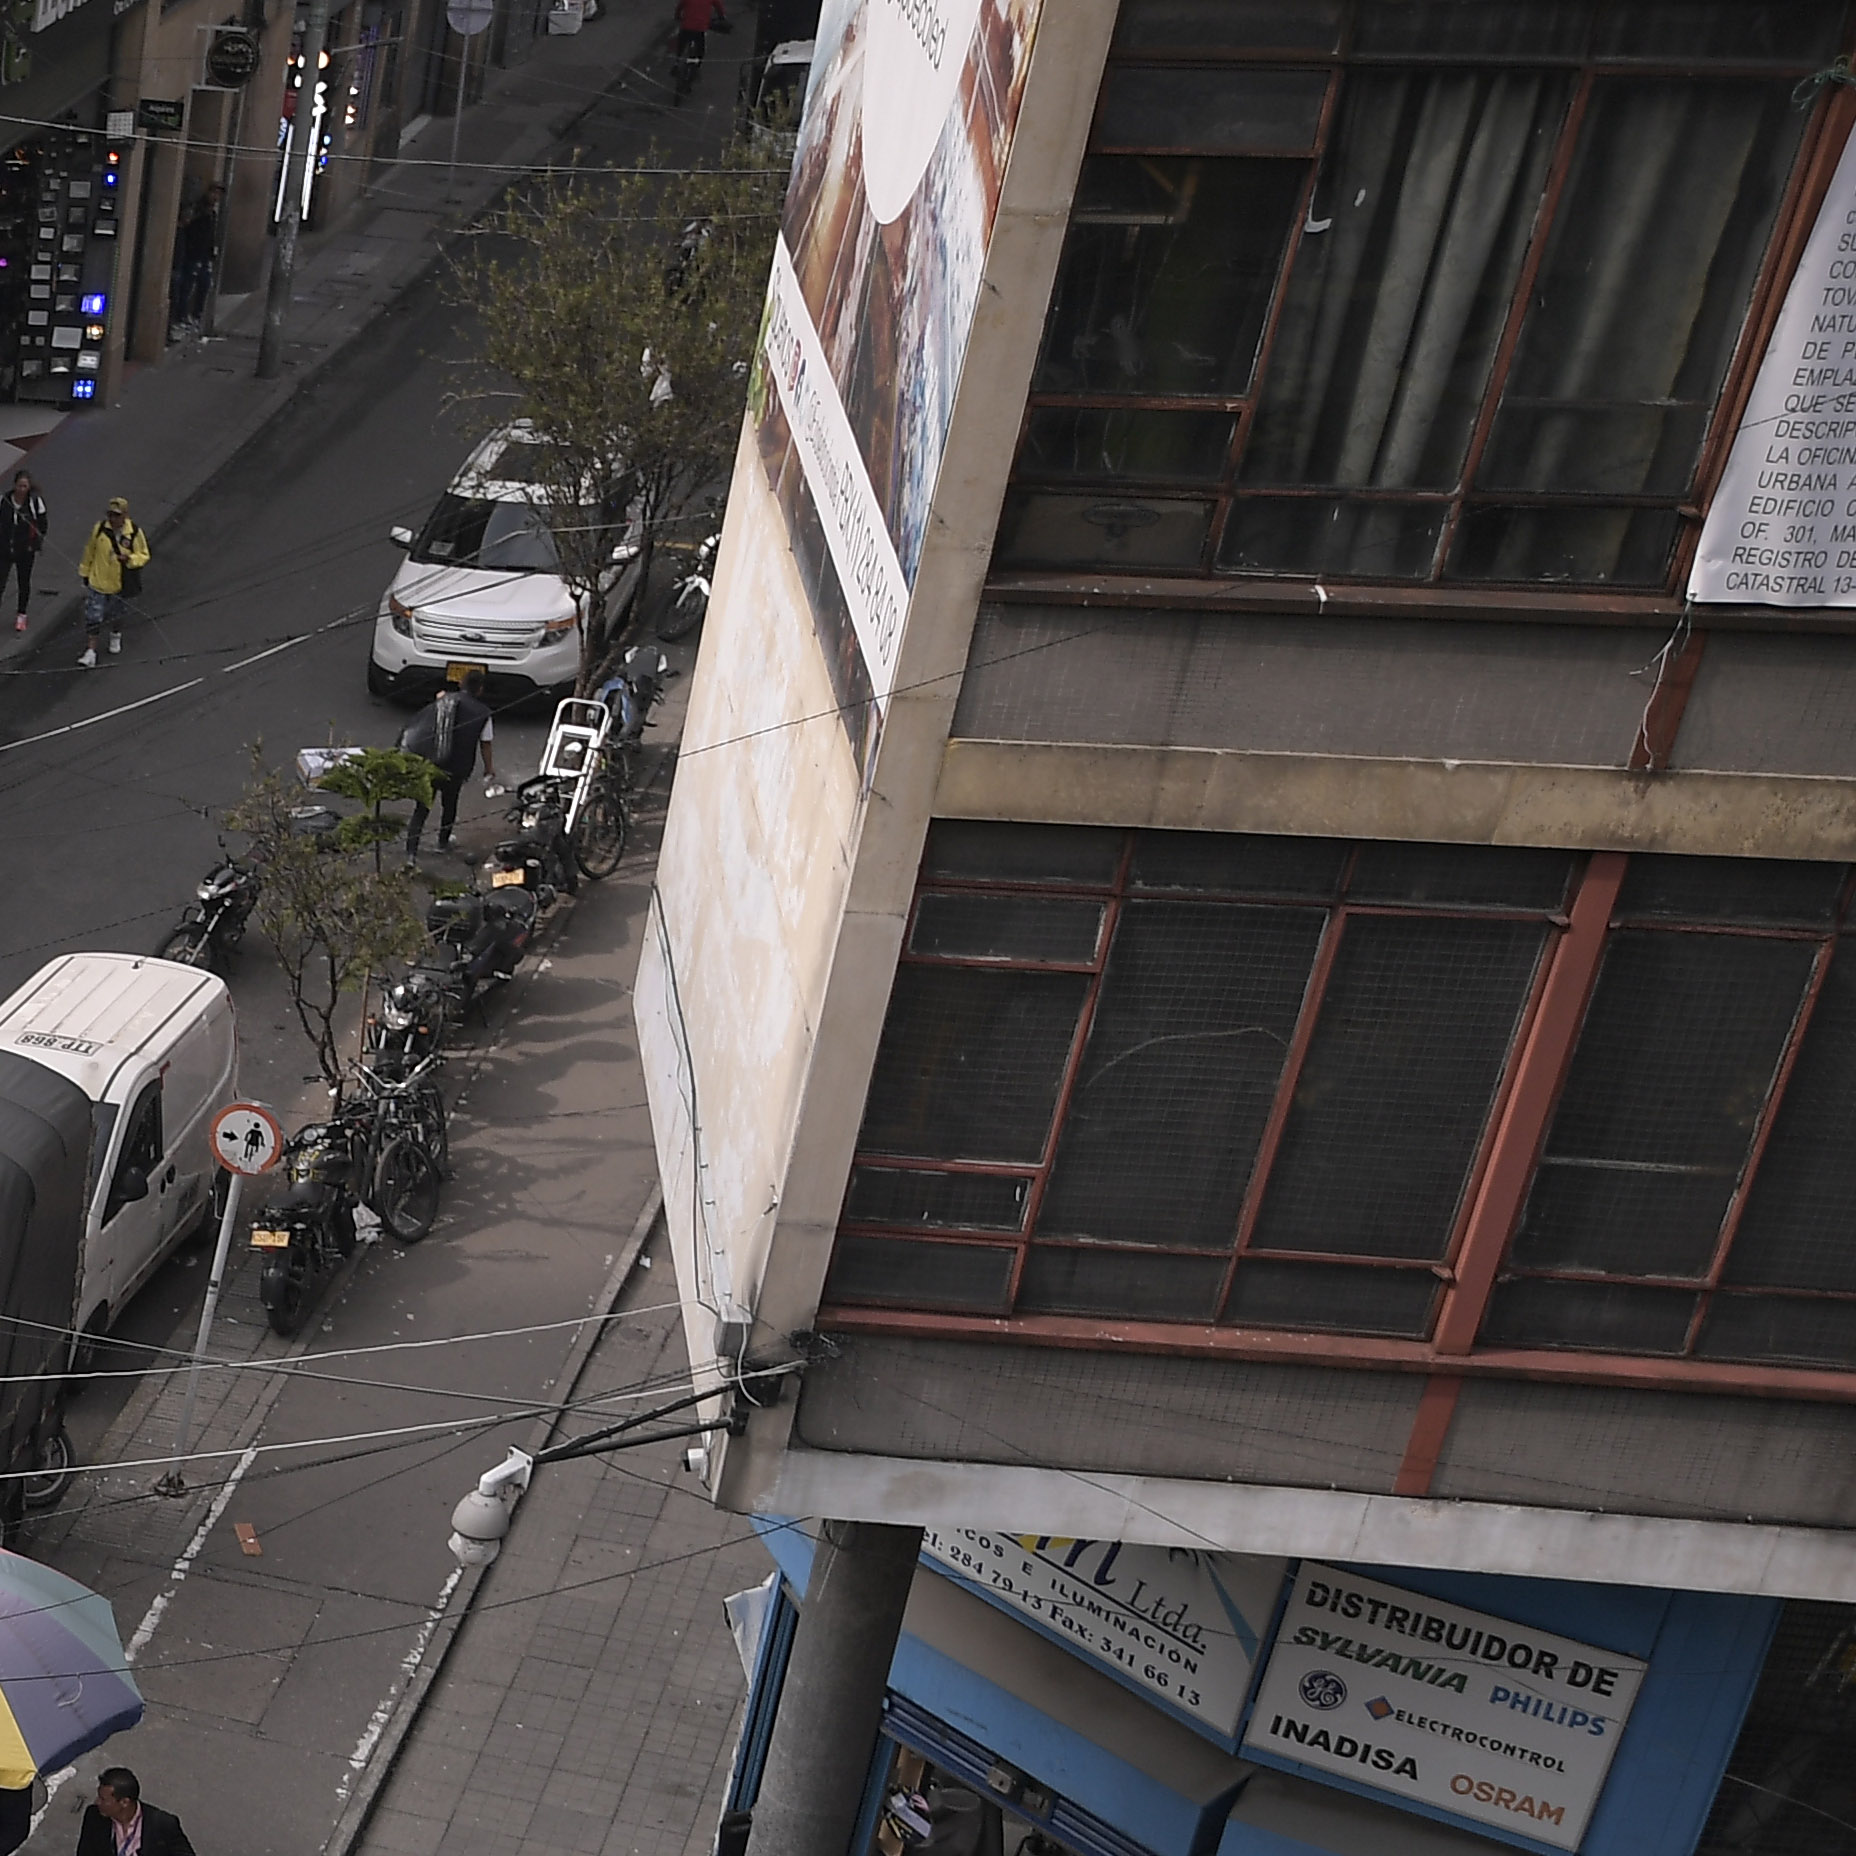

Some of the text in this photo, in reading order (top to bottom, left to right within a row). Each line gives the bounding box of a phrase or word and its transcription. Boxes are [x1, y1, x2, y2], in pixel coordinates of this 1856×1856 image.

[1801, 340, 1831, 361] DE
[1784, 394, 1827, 414] QUE
[1757, 470, 1837, 492] URBANA
[1765, 445, 1789, 465] LA
[1740, 521, 1770, 541] OF.
[1748, 496, 1835, 518] EDIFICIO
[1725, 571, 1826, 595] CATASTRAL
[1731, 546, 1828, 569] REGISTRO
[949, 1545, 984, 1575] 284
[992, 1569, 1014, 1592] 79
[1020, 1590, 1043, 1610] 13
[1048, 1604, 1093, 1643] Fax:
[1099, 1637, 1136, 1668] 341
[1144, 1665, 1169, 1688] 66
[1177, 1684, 1201, 1706] 13
[1021, 1560, 1034, 1576] E
[1050, 1578, 1199, 1675] ILUMINACIÓN
[1125, 1579, 1207, 1650] Ltda.
[1305, 1579, 1619, 1698] DISTRIBUIDOR DE
[1293, 1625, 1469, 1694] SYLVANIA
[1489, 1684, 1606, 1737] PHILIPS
[1269, 1714, 1420, 1781] INADISA
[1394, 1708, 1567, 1774] ELECTROCONTROL
[1449, 1773, 1566, 1827] OSRAM
